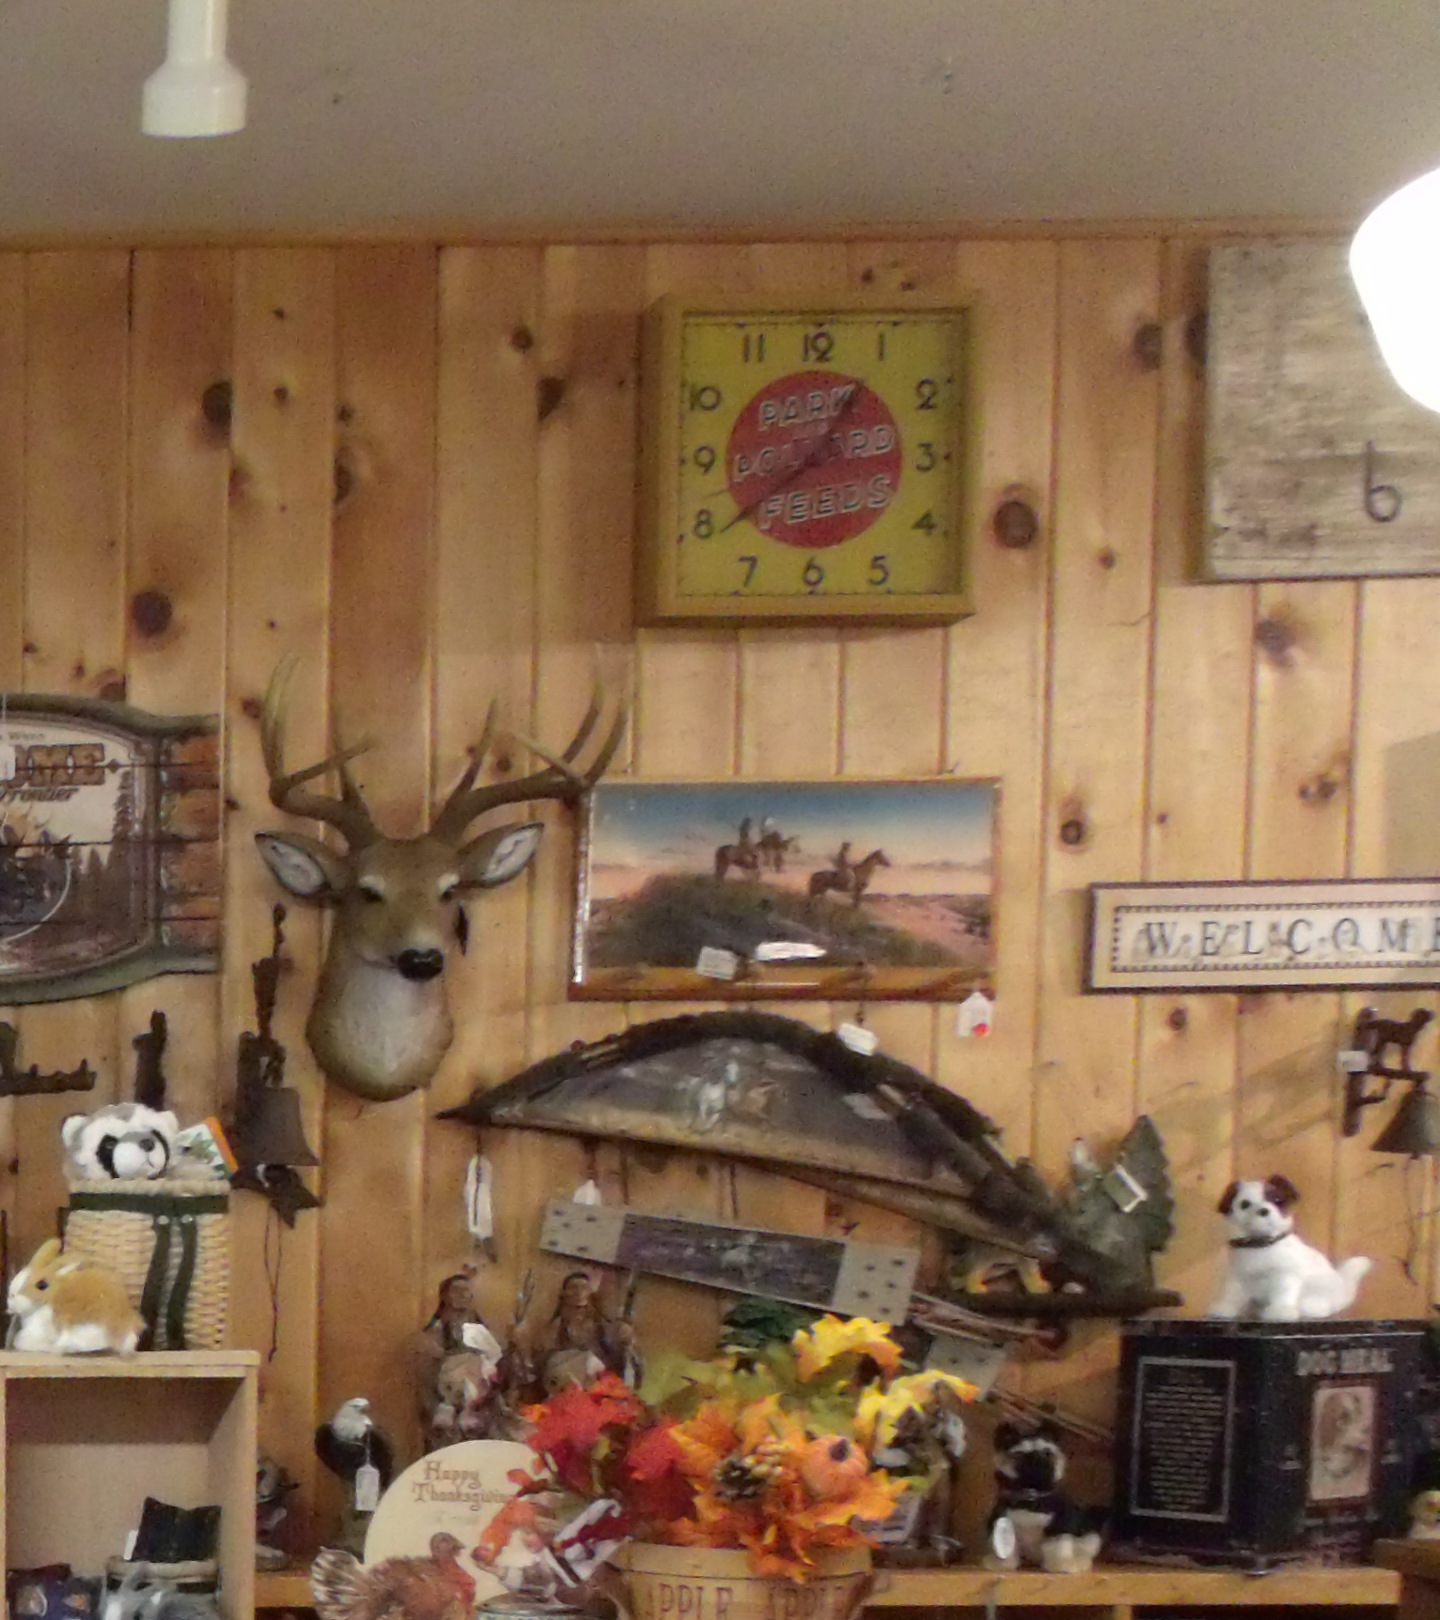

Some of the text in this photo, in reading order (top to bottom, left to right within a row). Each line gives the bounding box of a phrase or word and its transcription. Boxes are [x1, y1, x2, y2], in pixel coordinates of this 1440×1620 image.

[741, 333, 767, 363] 11
[801, 333, 834, 363] 12
[875, 331, 886, 363] 1
[687, 384, 723, 412] 10
[915, 379, 940, 412] 2
[693, 444, 716, 475] 9
[915, 443, 938, 473] 3
[758, 474, 893, 531] FEEDS
[693, 509, 715, 540] 8
[912, 508, 940, 537] 4
[737, 556, 760, 587] 7
[803, 556, 825, 587] 6
[869, 555, 890, 585] 5
[423, 1459, 482, 1490] Happy
[411, 1480, 514, 1512] Thanksgivin
